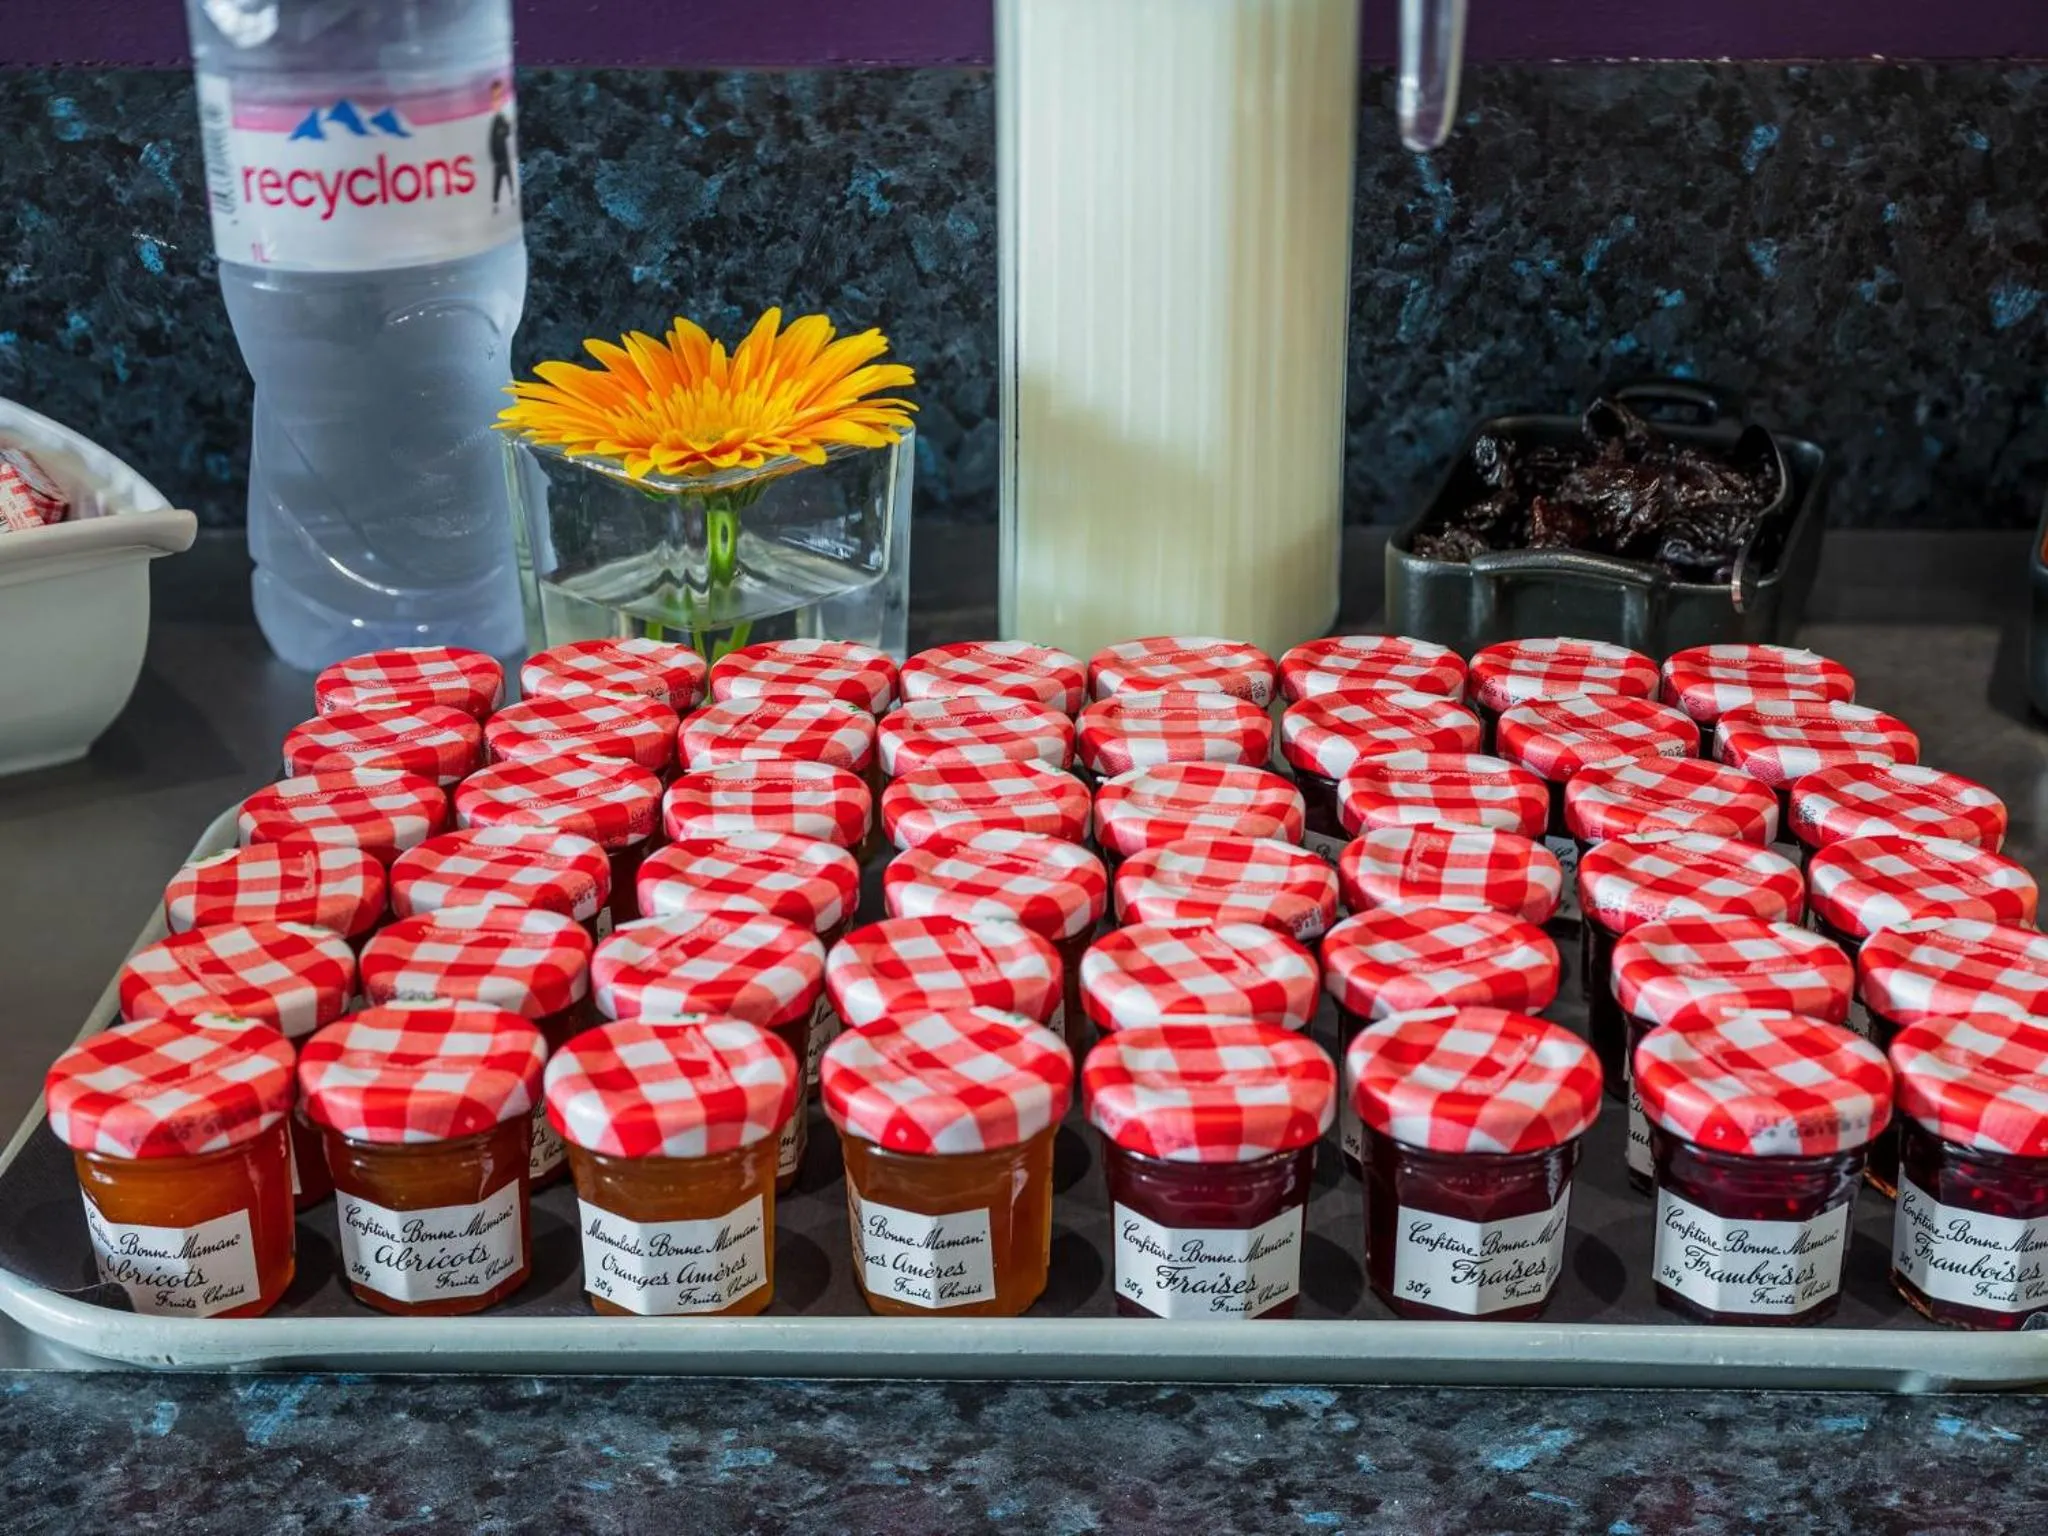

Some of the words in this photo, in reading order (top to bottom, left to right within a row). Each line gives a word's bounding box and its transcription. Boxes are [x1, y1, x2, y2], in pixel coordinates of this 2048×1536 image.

[241, 152, 478, 222] recyclons
[346, 1203, 400, 1244] Confiture
[400, 1218, 457, 1245] Bonne
[869, 1214, 915, 1246] Bonne
[1664, 1204, 1722, 1251] Confiture
[1723, 1229, 1781, 1256] Bonne
[1902, 1190, 1945, 1240] Confiture
[1946, 1218, 2003, 1251] Bonne
[120, 1232, 172, 1259] Bonne
[585, 1217, 645, 1258] Marmelade
[649, 1232, 706, 1258] Bonne
[1123, 1219, 1179, 1263] Confiture
[1180, 1239, 1236, 1264] Bonne
[1408, 1220, 1479, 1257] Confiture
[1480, 1230, 1530, 1258] Bonne
[374, 1240, 491, 1273] Abricots
[601, 1251, 671, 1291] Oranges
[676, 1252, 748, 1286] Amères
[892, 1251, 968, 1280] Amères
[1450, 1256, 1547, 1289] Fraises
[1684, 1244, 1817, 1286] Framboises
[1914, 1231, 2044, 1283] Framboises
[435, 1269, 480, 1290] Fruits
[893, 1276, 932, 1301] Fruits
[938, 1281, 984, 1301] Choisis
[1155, 1264, 1258, 1295] Fraises
[1502, 1279, 1542, 1301] Fruits
[1749, 1286, 1796, 1305] Fruits
[1972, 1281, 2020, 1303] Fruits
[155, 1289, 197, 1309] Fruits
[202, 1283, 246, 1305] Choisis
[678, 1287, 723, 1307] Fruits
[1209, 1295, 1254, 1313] Fruits
